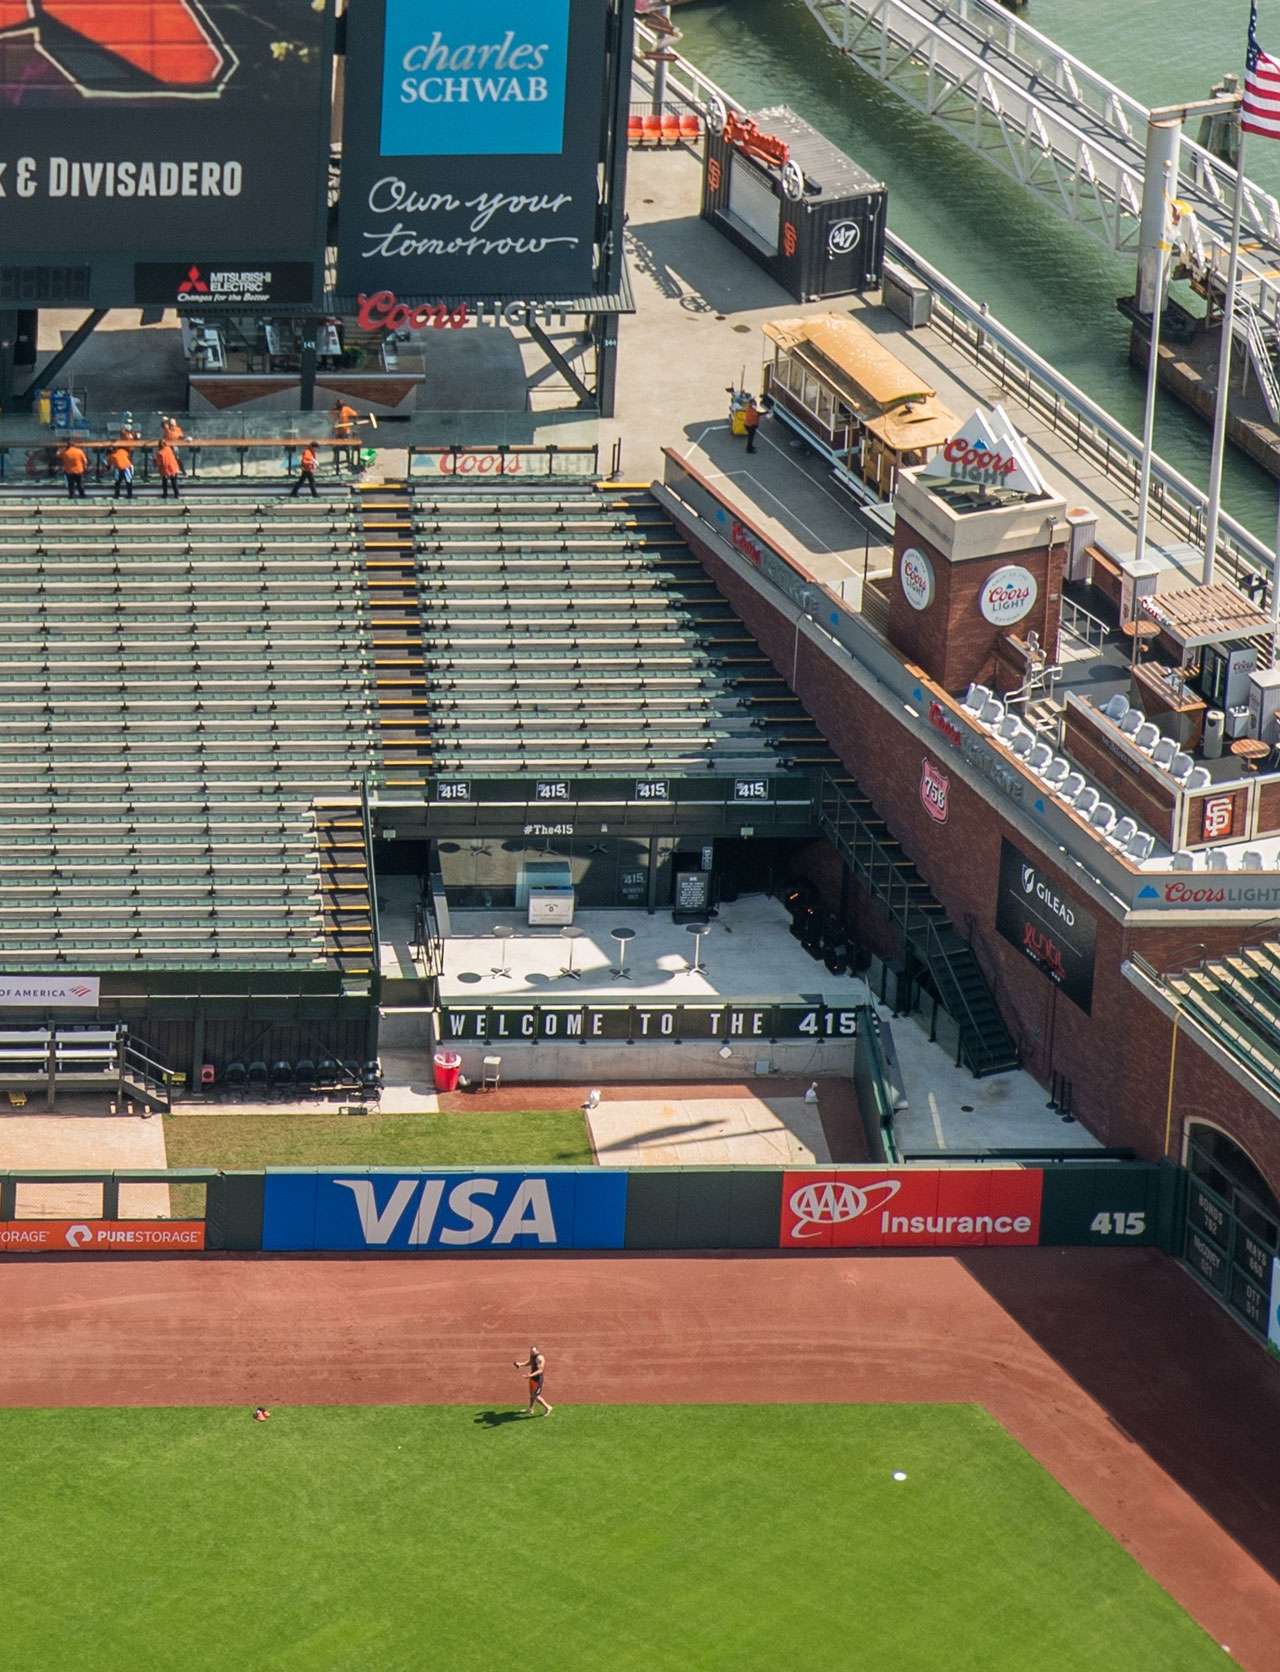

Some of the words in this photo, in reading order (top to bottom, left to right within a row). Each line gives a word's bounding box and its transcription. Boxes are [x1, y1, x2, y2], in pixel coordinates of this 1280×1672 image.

[402, 30, 549, 72] charles
[400, 77, 548, 103] SCHWAB
[16, 157, 38, 198] &
[368, 176, 459, 213] Own
[465, 194, 572, 232] your
[361, 222, 579, 258] tomorrow
[210, 272, 272, 283] MITSUBISHI
[210, 283, 263, 292] ELECTRIC
[357, 290, 469, 331] Coors
[476, 300, 574, 327] LIGHT
[439, 449, 522, 474] Coors
[943, 438, 1017, 473] Coors
[950, 464, 1007, 486] LIGHT
[988, 586, 1031, 604] Coors
[992, 599, 1025, 612] LIGHT
[441, 784, 466, 798] 415
[540, 784, 565, 798] 415
[640, 782, 665, 797] 415
[739, 782, 764, 797] 415
[524, 825, 573, 835] #The415
[1036, 882, 1075, 926] GILEAD
[1165, 882, 1225, 903] Coors
[15, 988, 66, 998] AMERICA
[450, 1012, 603, 1036] WELCOME
[640, 1012, 674, 1034] TO
[711, 1012, 763, 1034] THE
[798, 1012, 856, 1034] 415
[332, 1178, 558, 1245] VISA
[797, 1183, 861, 1221] AAA
[880, 1211, 1032, 1234] Insurance
[1090, 1212, 1146, 1235] 415
